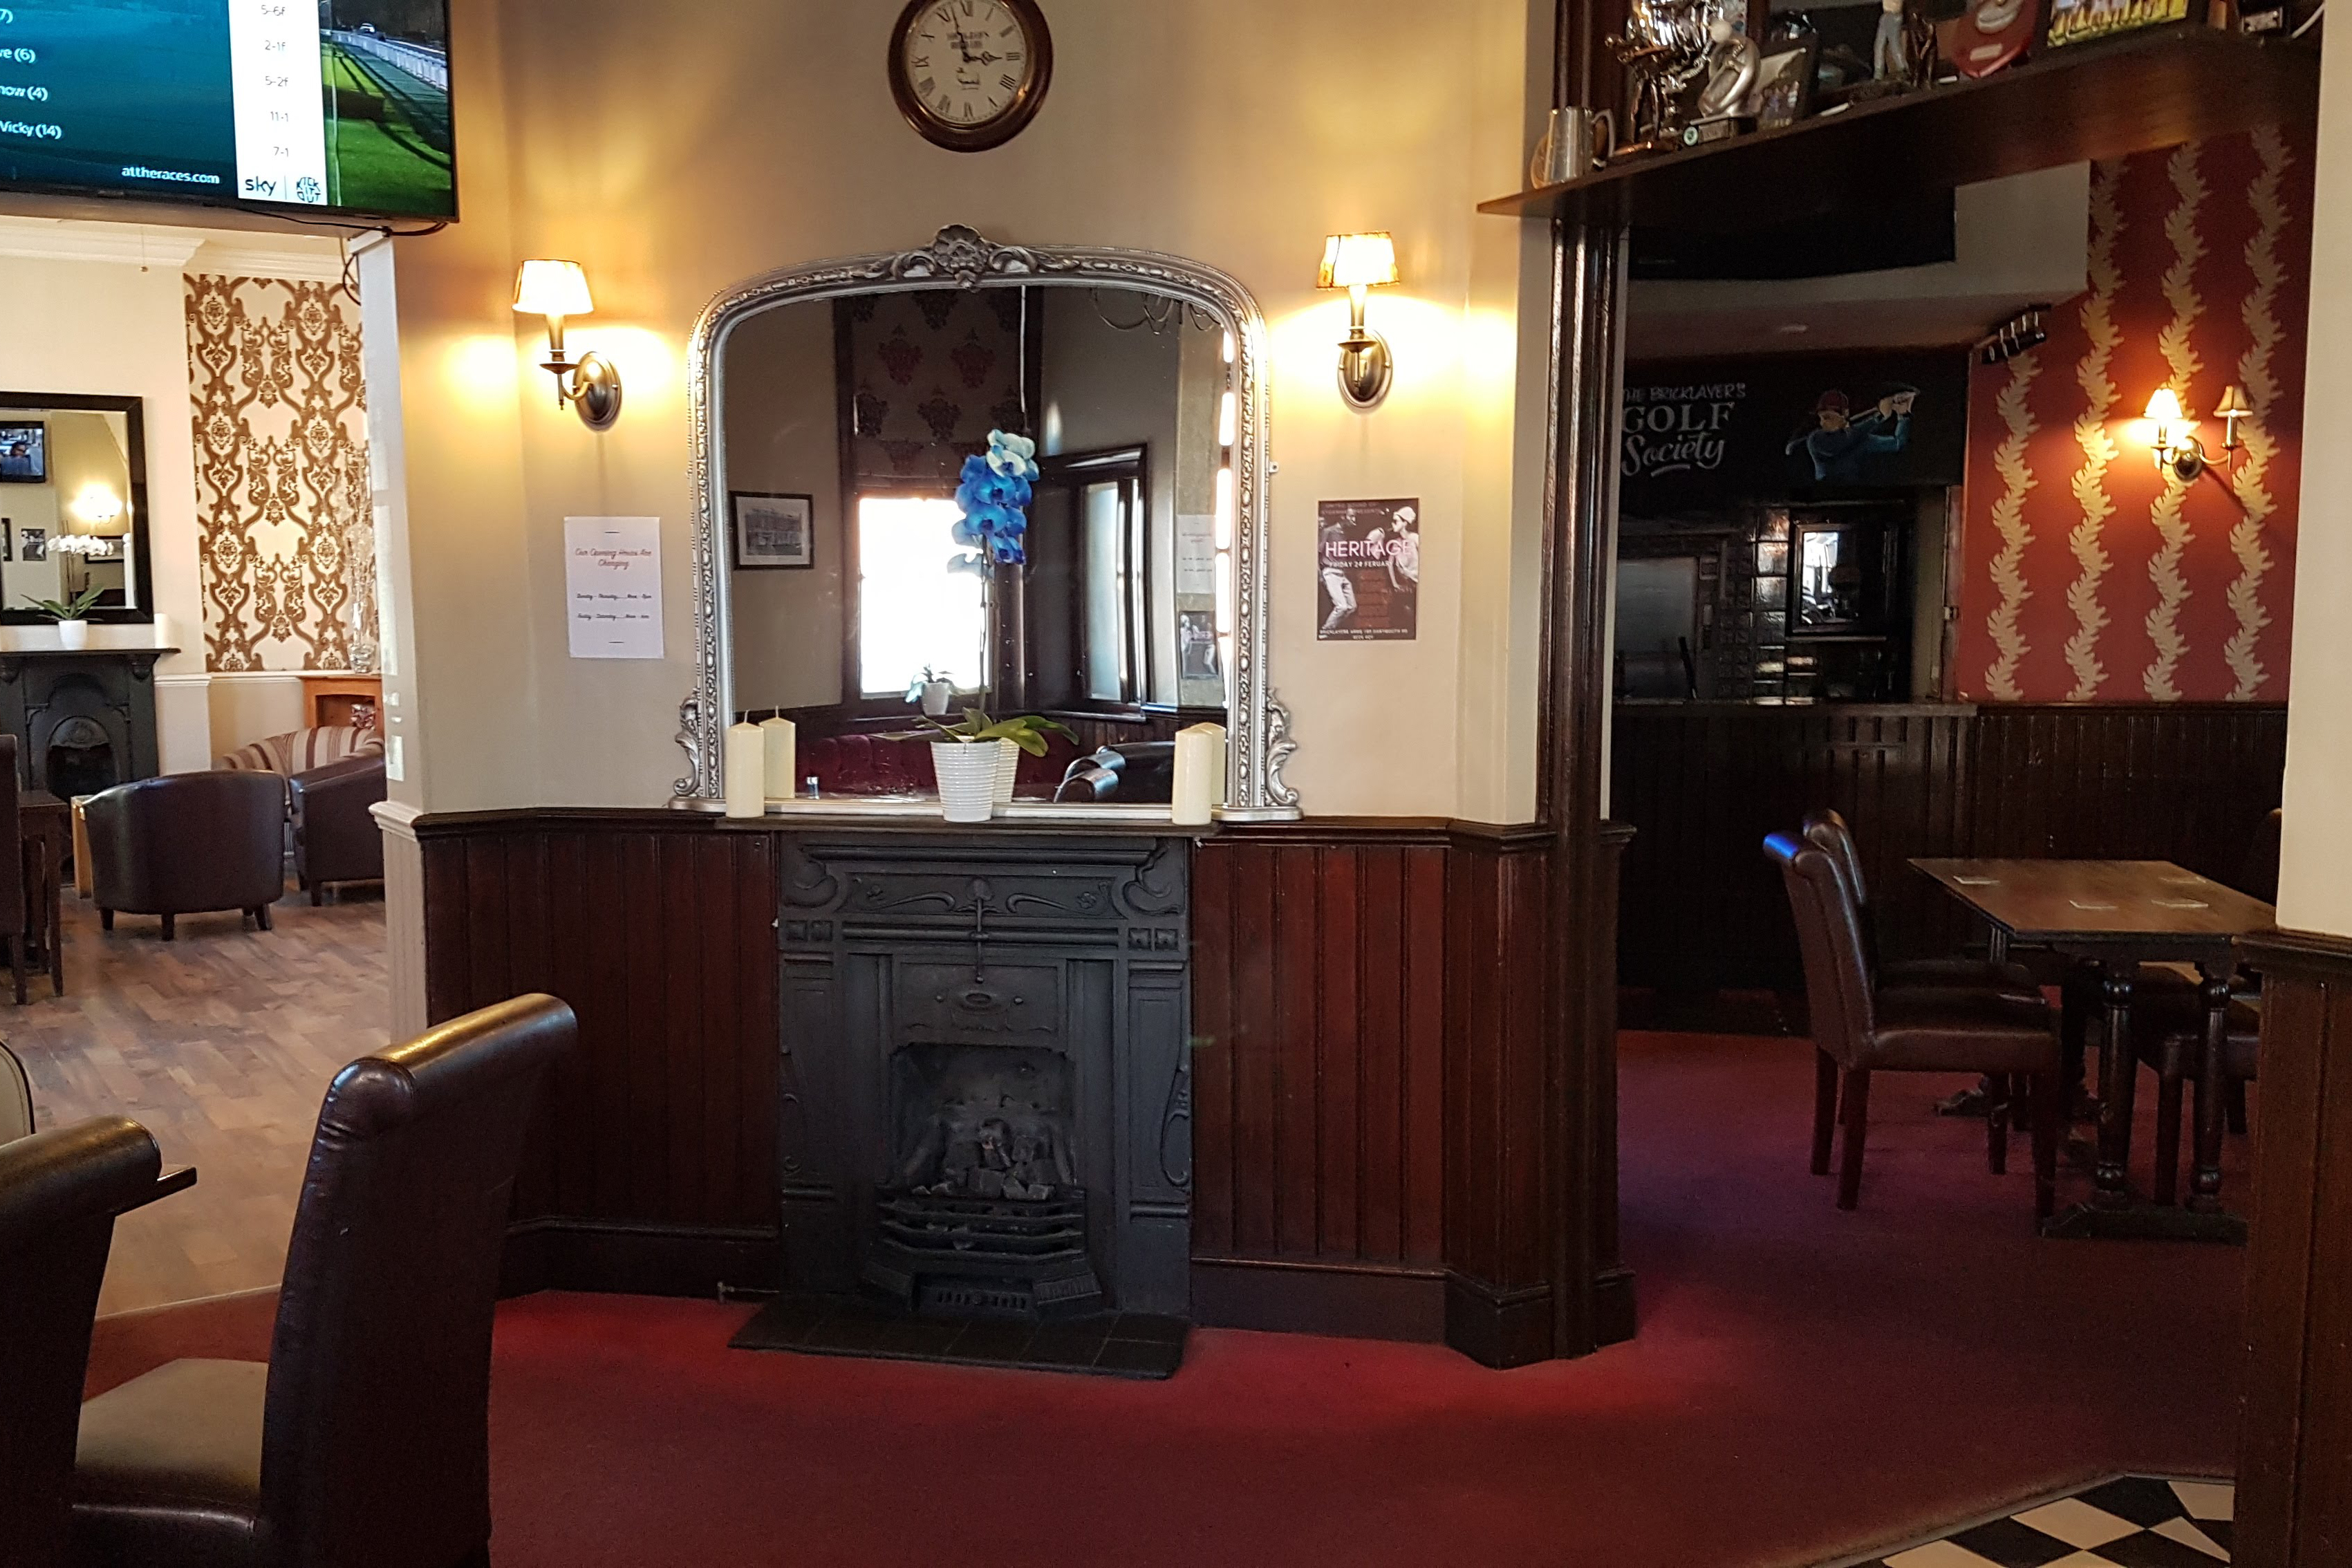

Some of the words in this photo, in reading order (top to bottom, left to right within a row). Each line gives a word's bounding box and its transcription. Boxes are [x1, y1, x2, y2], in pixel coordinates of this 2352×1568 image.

[14, 48, 36, 64] (6)
[26, 86, 48, 102] (4)
[270, 111, 289, 122] 11-1
[0, 120, 34, 137] Vicky
[35, 124, 62, 140] (14)
[273, 146, 289, 158] 7-1
[122, 166, 221, 184] attheraces.com
[245, 176, 277, 196] sky
[1622, 401, 1735, 433] GOLF
[1621, 431, 1725, 476] Society
[1325, 539, 1412, 558] HERITAGE
